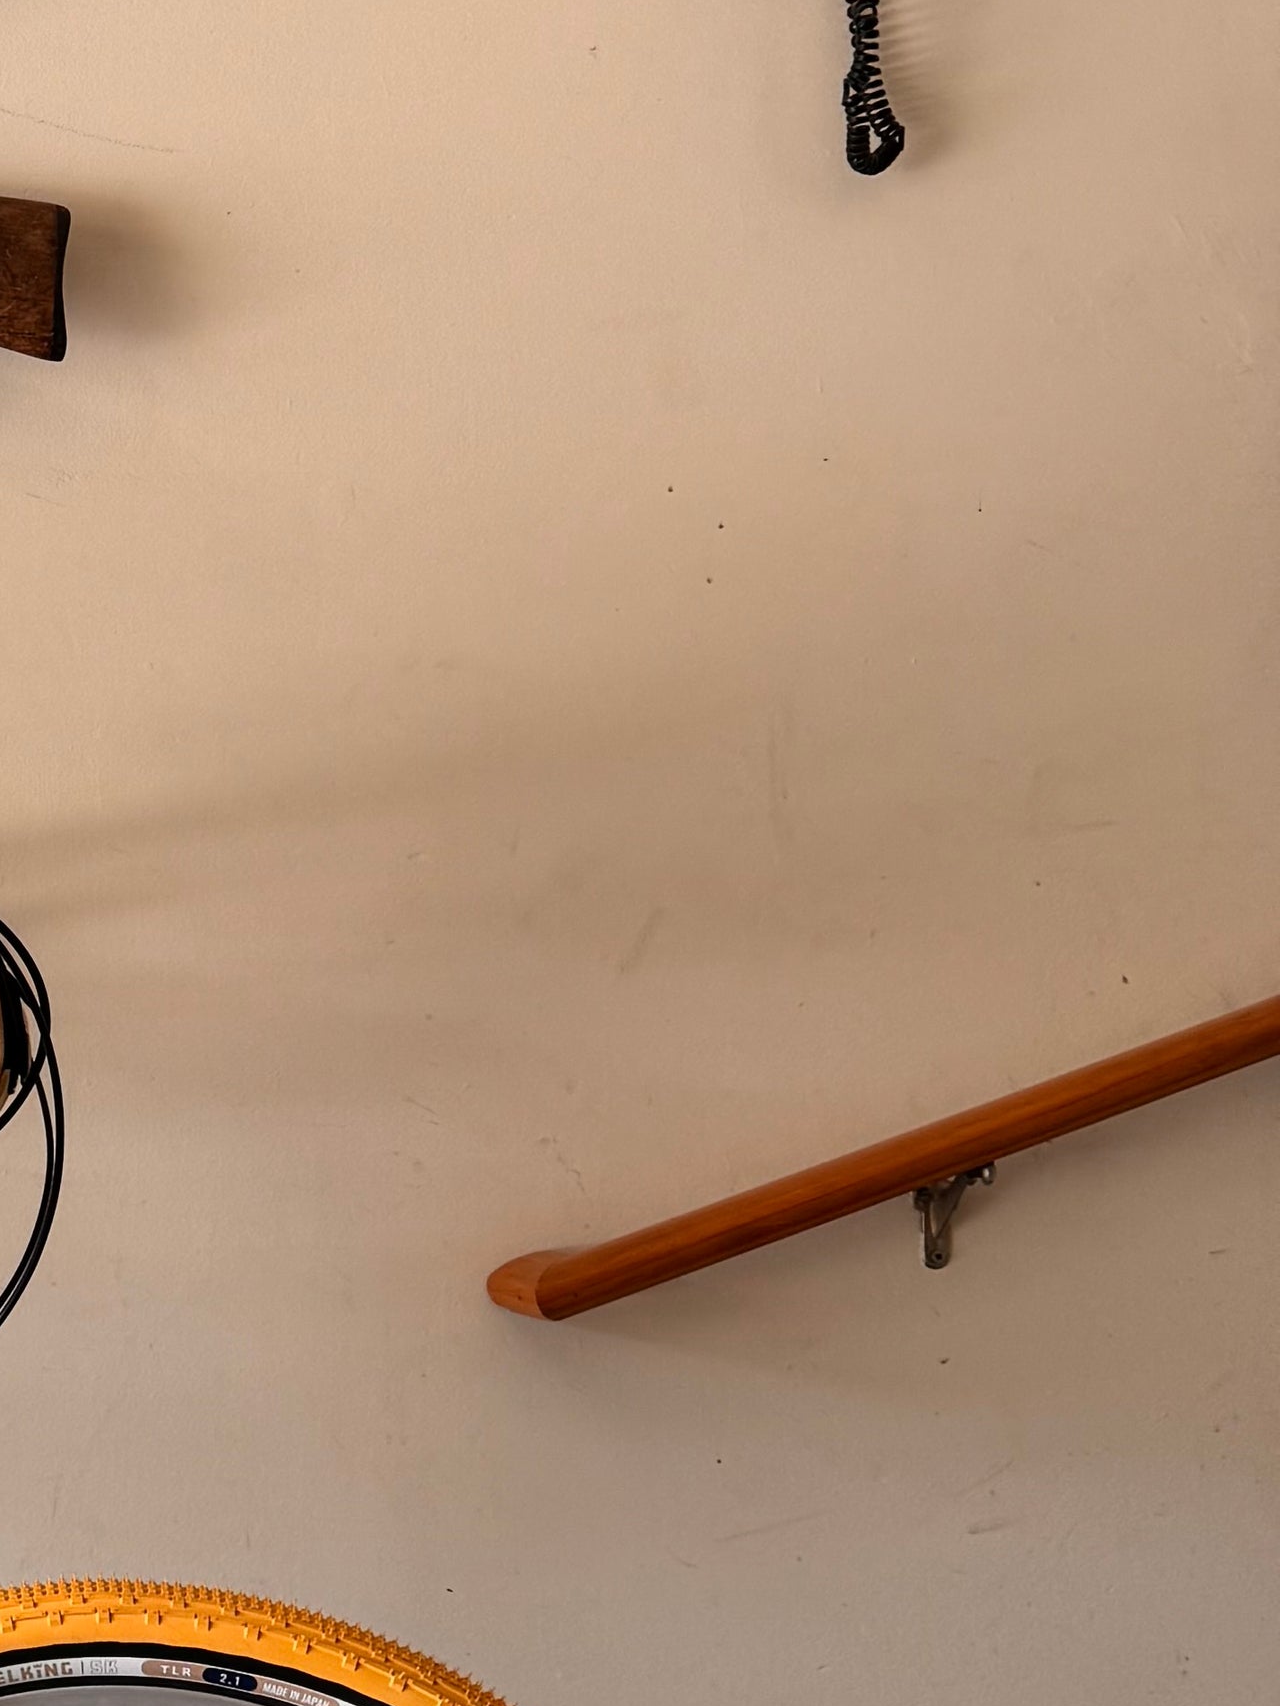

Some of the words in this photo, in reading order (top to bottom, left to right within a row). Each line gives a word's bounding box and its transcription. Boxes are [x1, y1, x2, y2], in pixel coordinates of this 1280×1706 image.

[89, 1659, 118, 1675] SK
[160, 1664, 192, 1678] TLR
[219, 1672, 240, 1687] 2.1
[262, 1681, 290, 1698] MADE
[290, 1689, 300, 1701] IN
